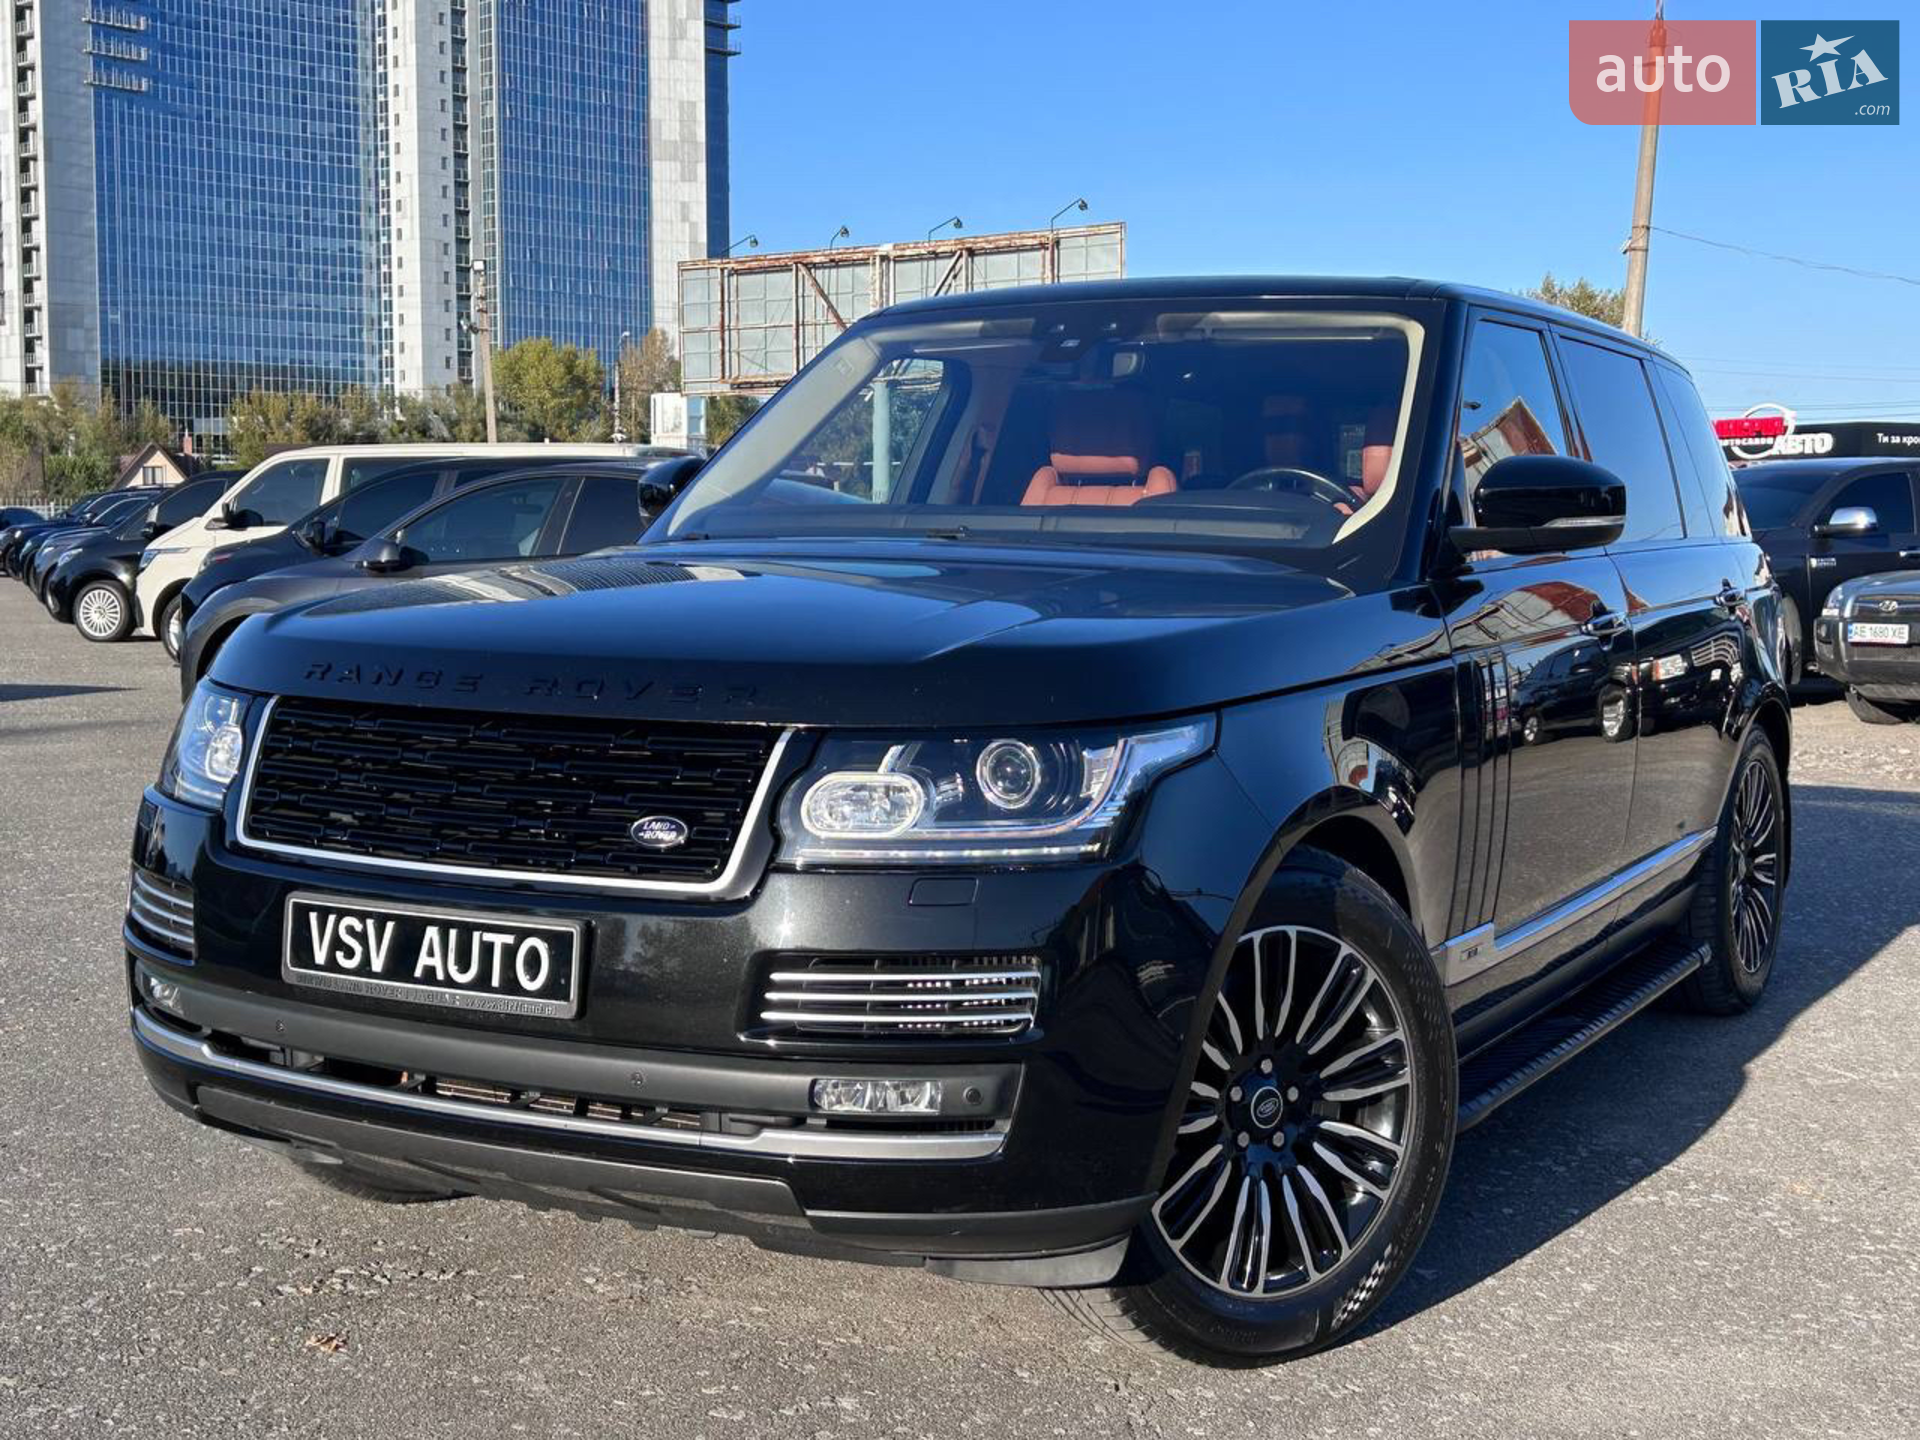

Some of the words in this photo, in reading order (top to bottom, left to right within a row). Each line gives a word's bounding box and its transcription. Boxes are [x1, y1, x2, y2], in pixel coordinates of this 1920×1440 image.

[303, 662, 484, 694] RANGE
[524, 672, 758, 704] ROVER
[643, 821, 670, 830] LAND
[643, 830, 677, 840] ROVER
[308, 911, 396, 973] VSV
[413, 926, 550, 991] AUTO
